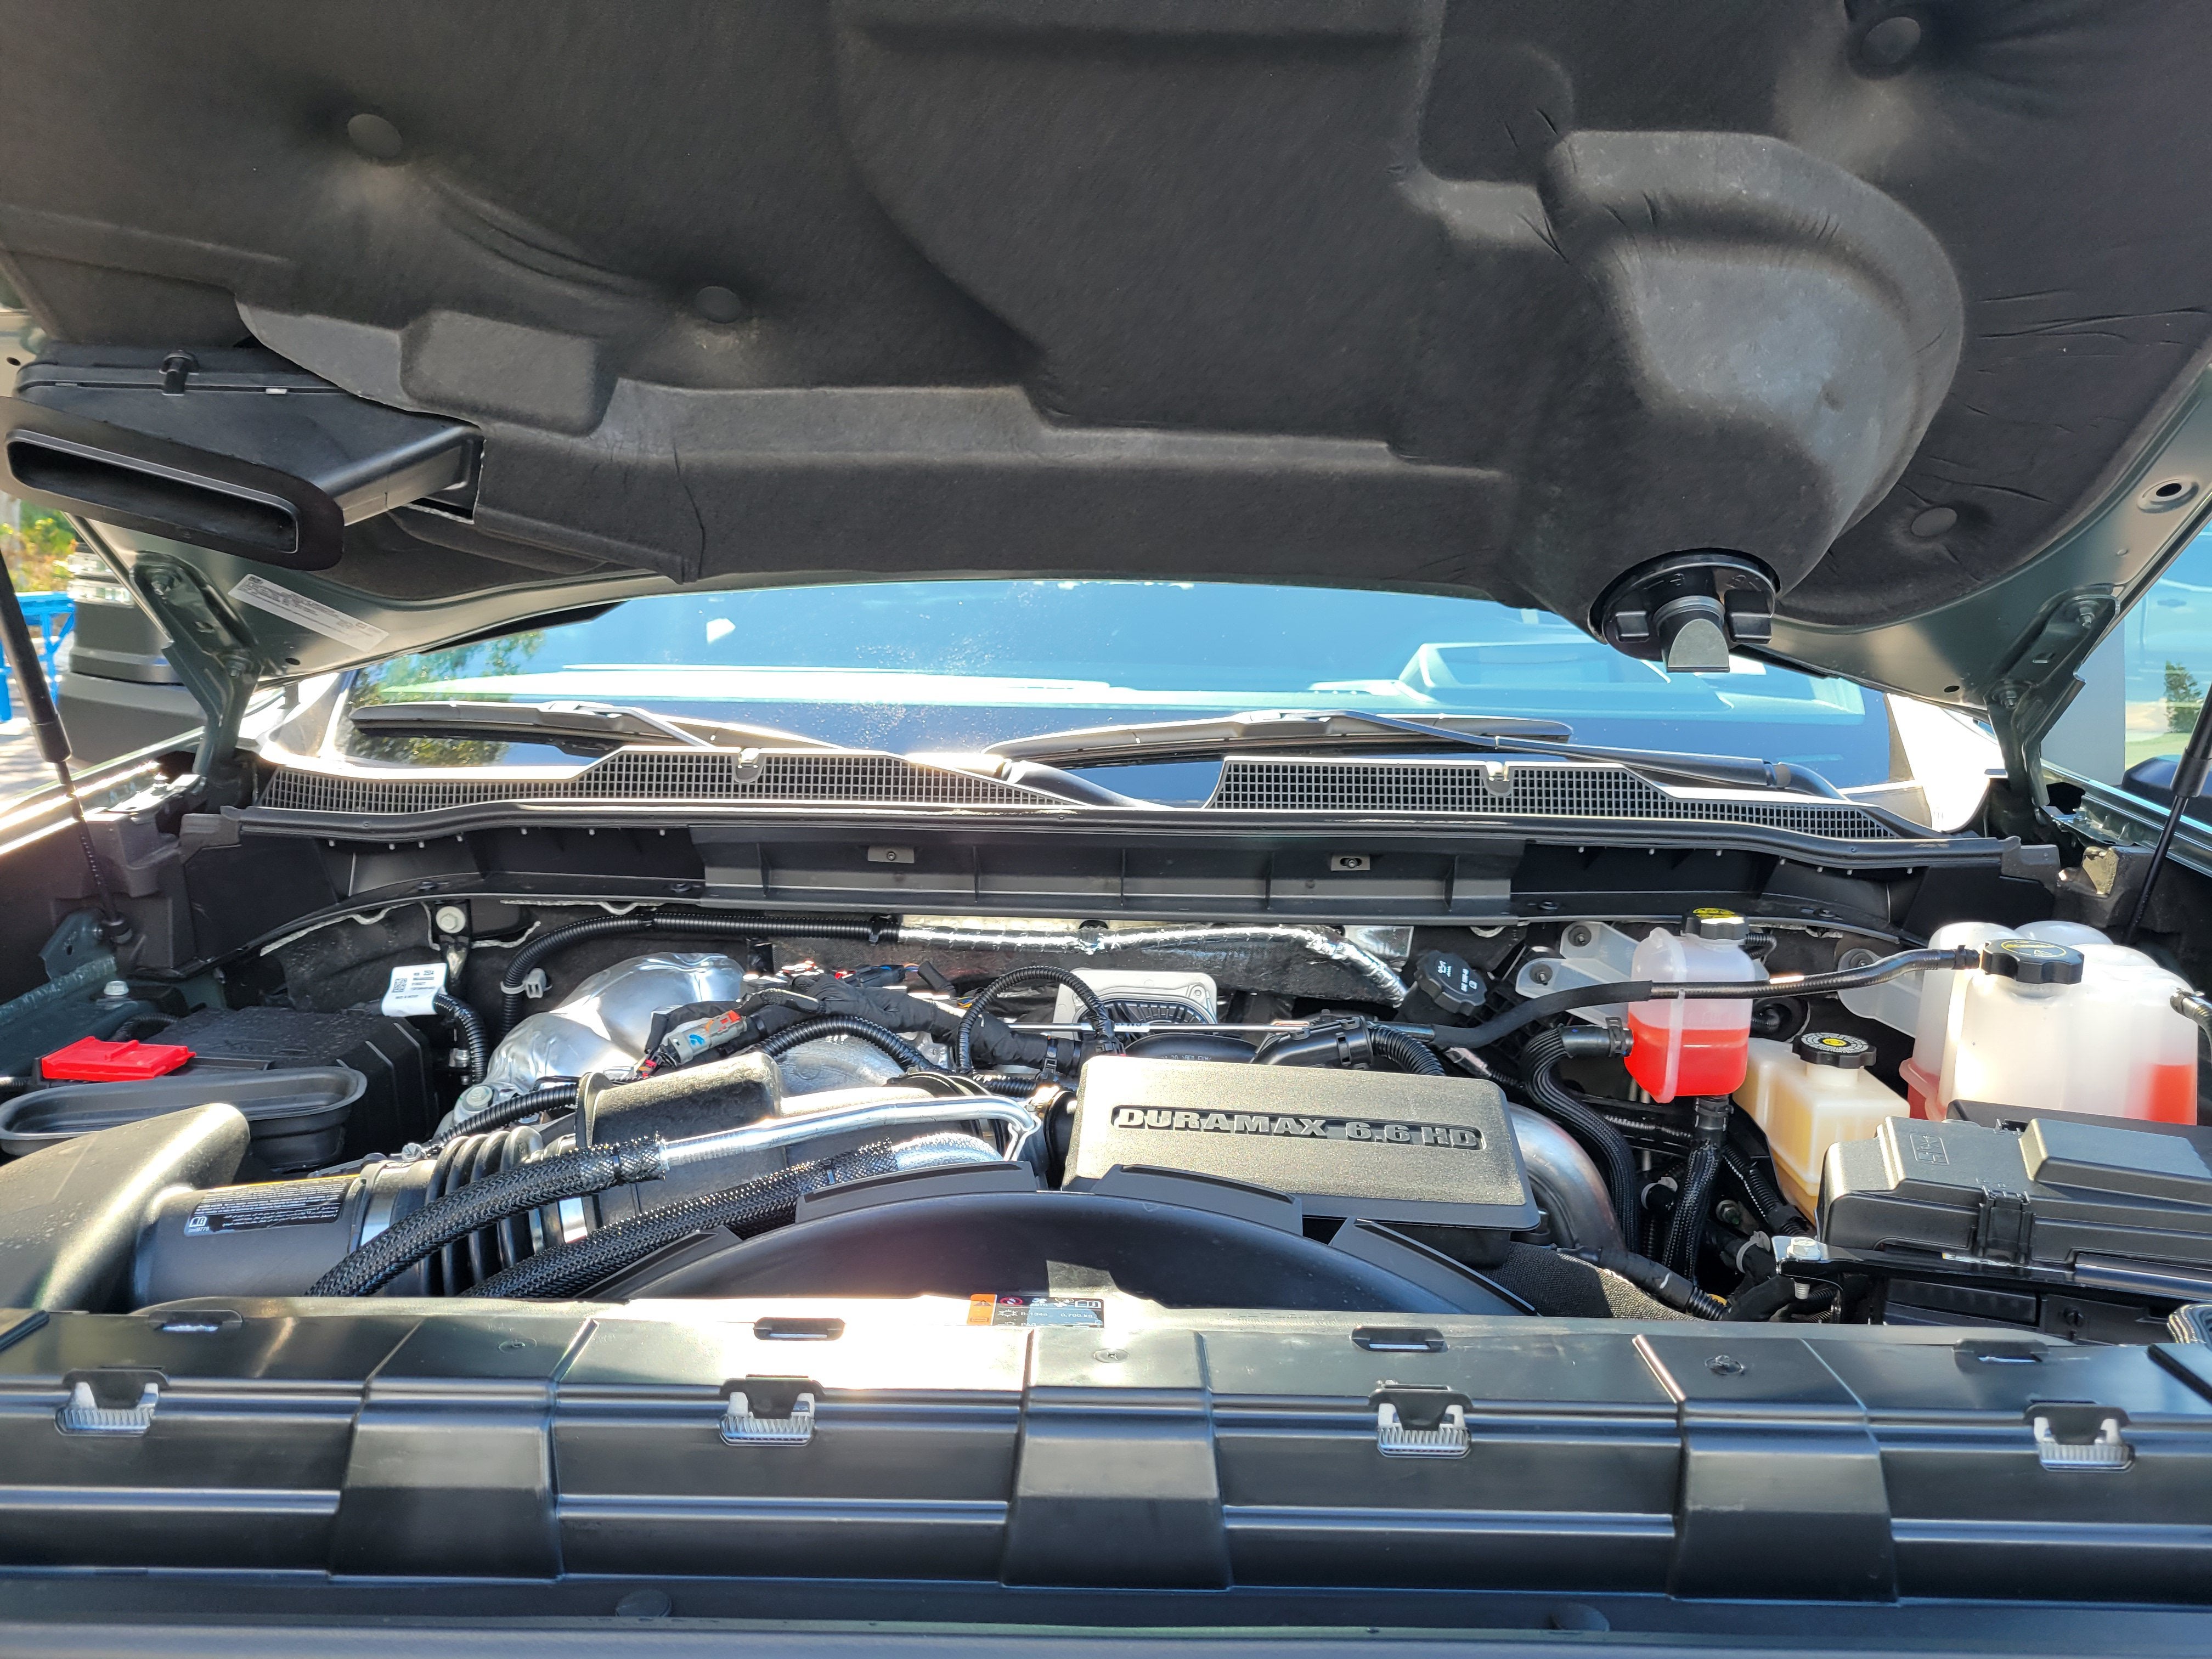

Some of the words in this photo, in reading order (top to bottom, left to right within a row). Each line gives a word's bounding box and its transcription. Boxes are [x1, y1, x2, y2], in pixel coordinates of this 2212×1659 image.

[1118, 1109, 1328, 1137] DURAMAX
[1346, 1121, 1410, 1142] 6.6
[1421, 1126, 1477, 1148] HD
